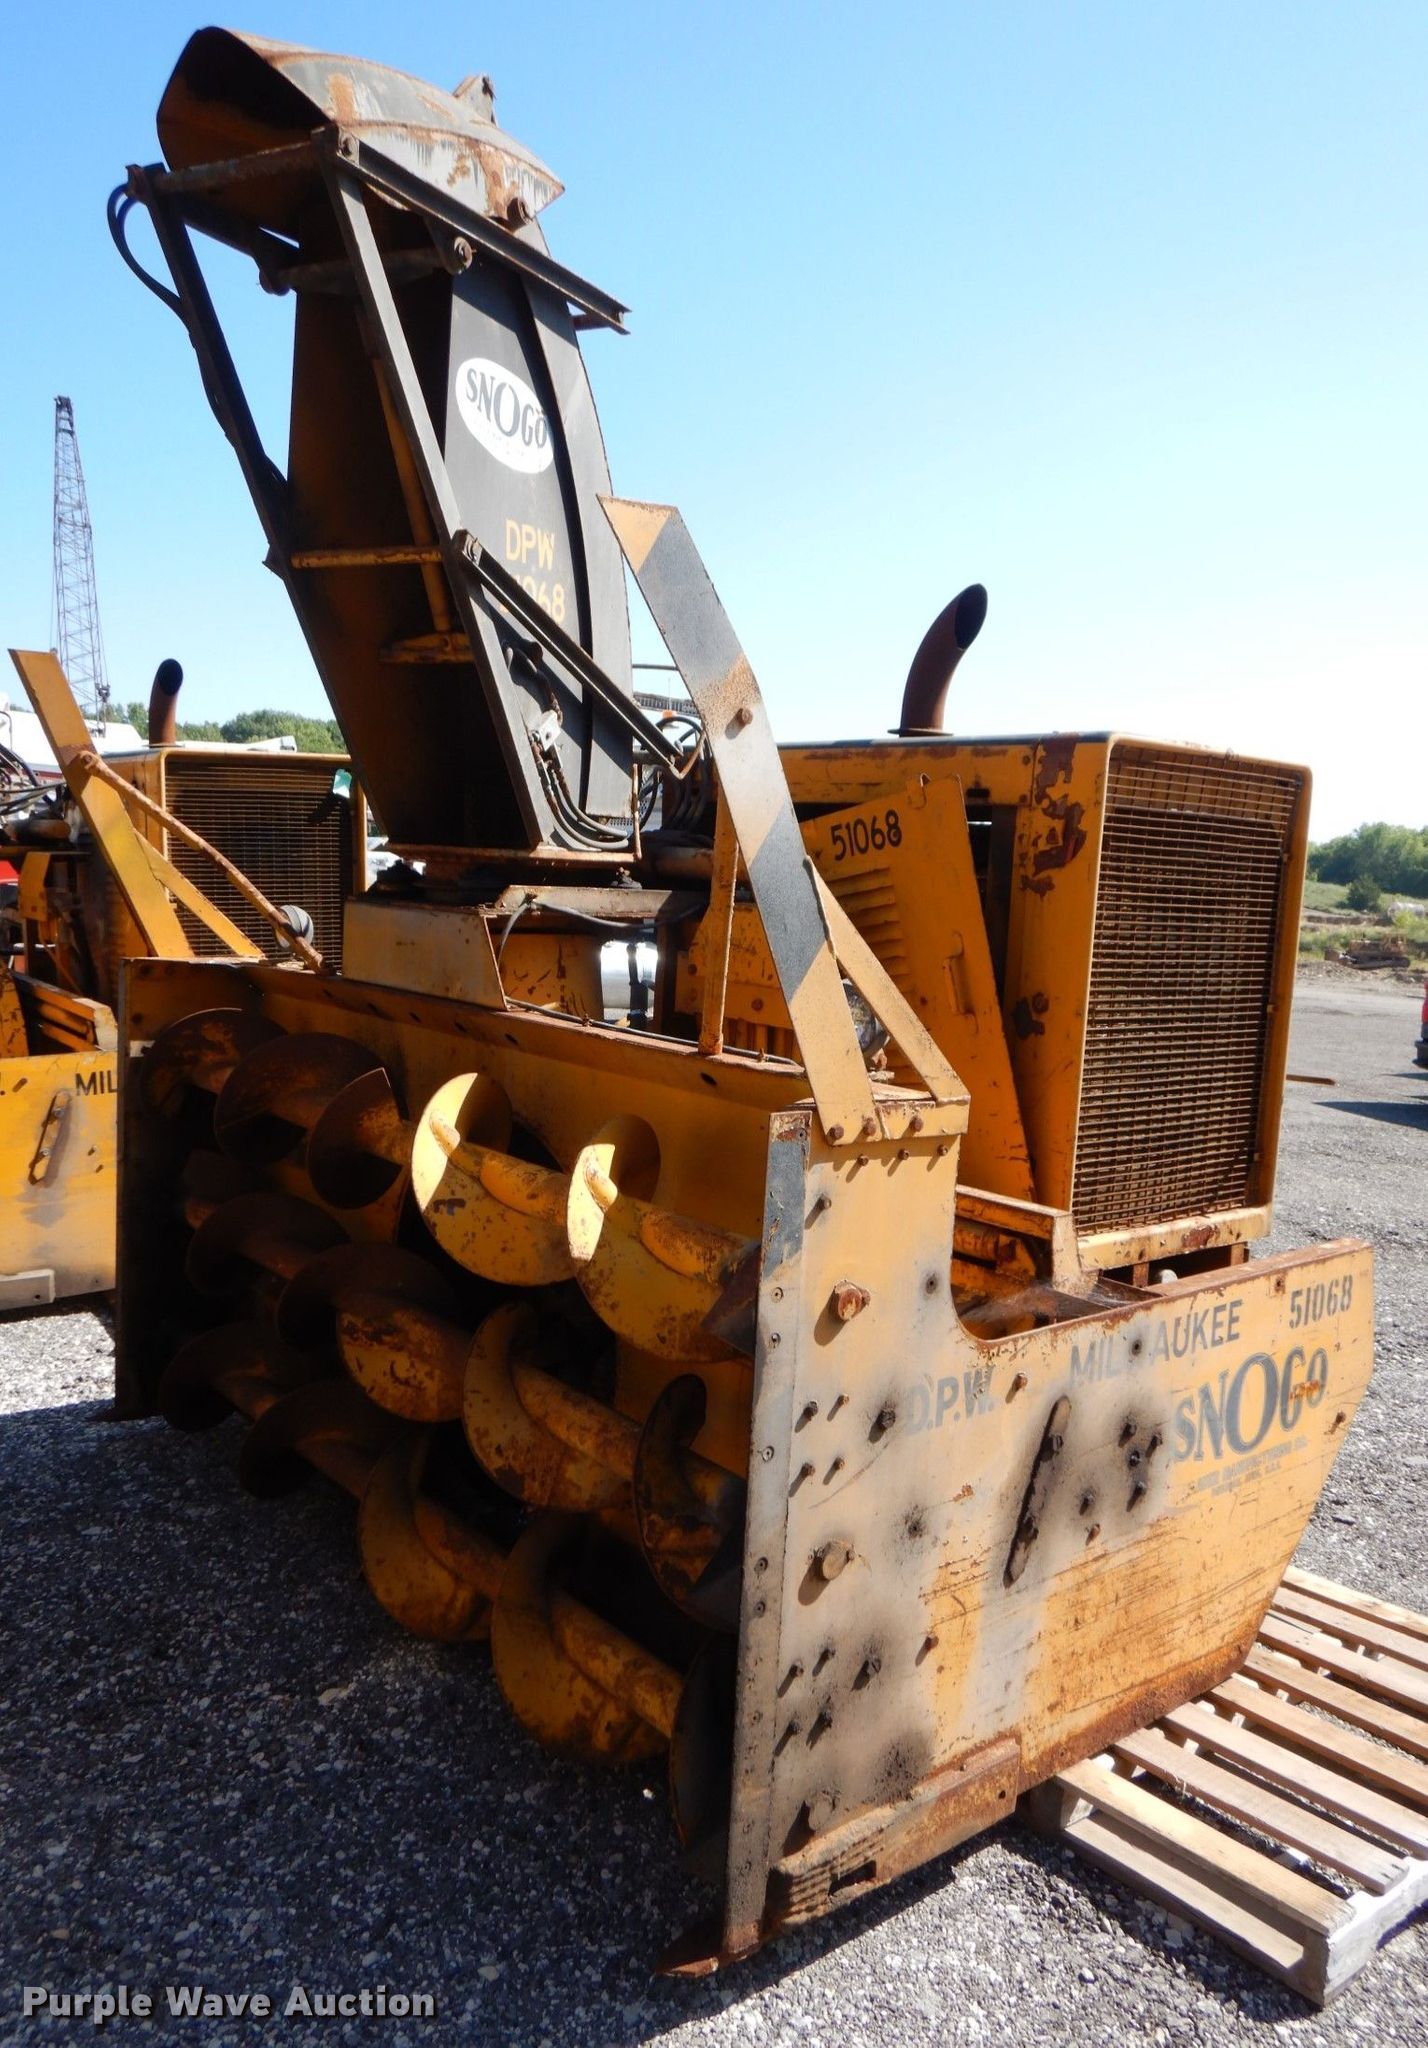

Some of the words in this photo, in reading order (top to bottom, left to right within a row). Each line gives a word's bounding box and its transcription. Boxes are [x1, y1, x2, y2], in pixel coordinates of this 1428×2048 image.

[465, 367, 549, 450] SNOGO
[505, 519, 555, 571] DPW
[830, 809, 903, 862] 51068
[904, 1364, 996, 1436] D.P.W.
[1069, 1298, 1244, 1388] MILAUKEE
[1288, 1274, 1354, 1330] 51068
[1172, 1346, 1329, 1463] SNOGO
